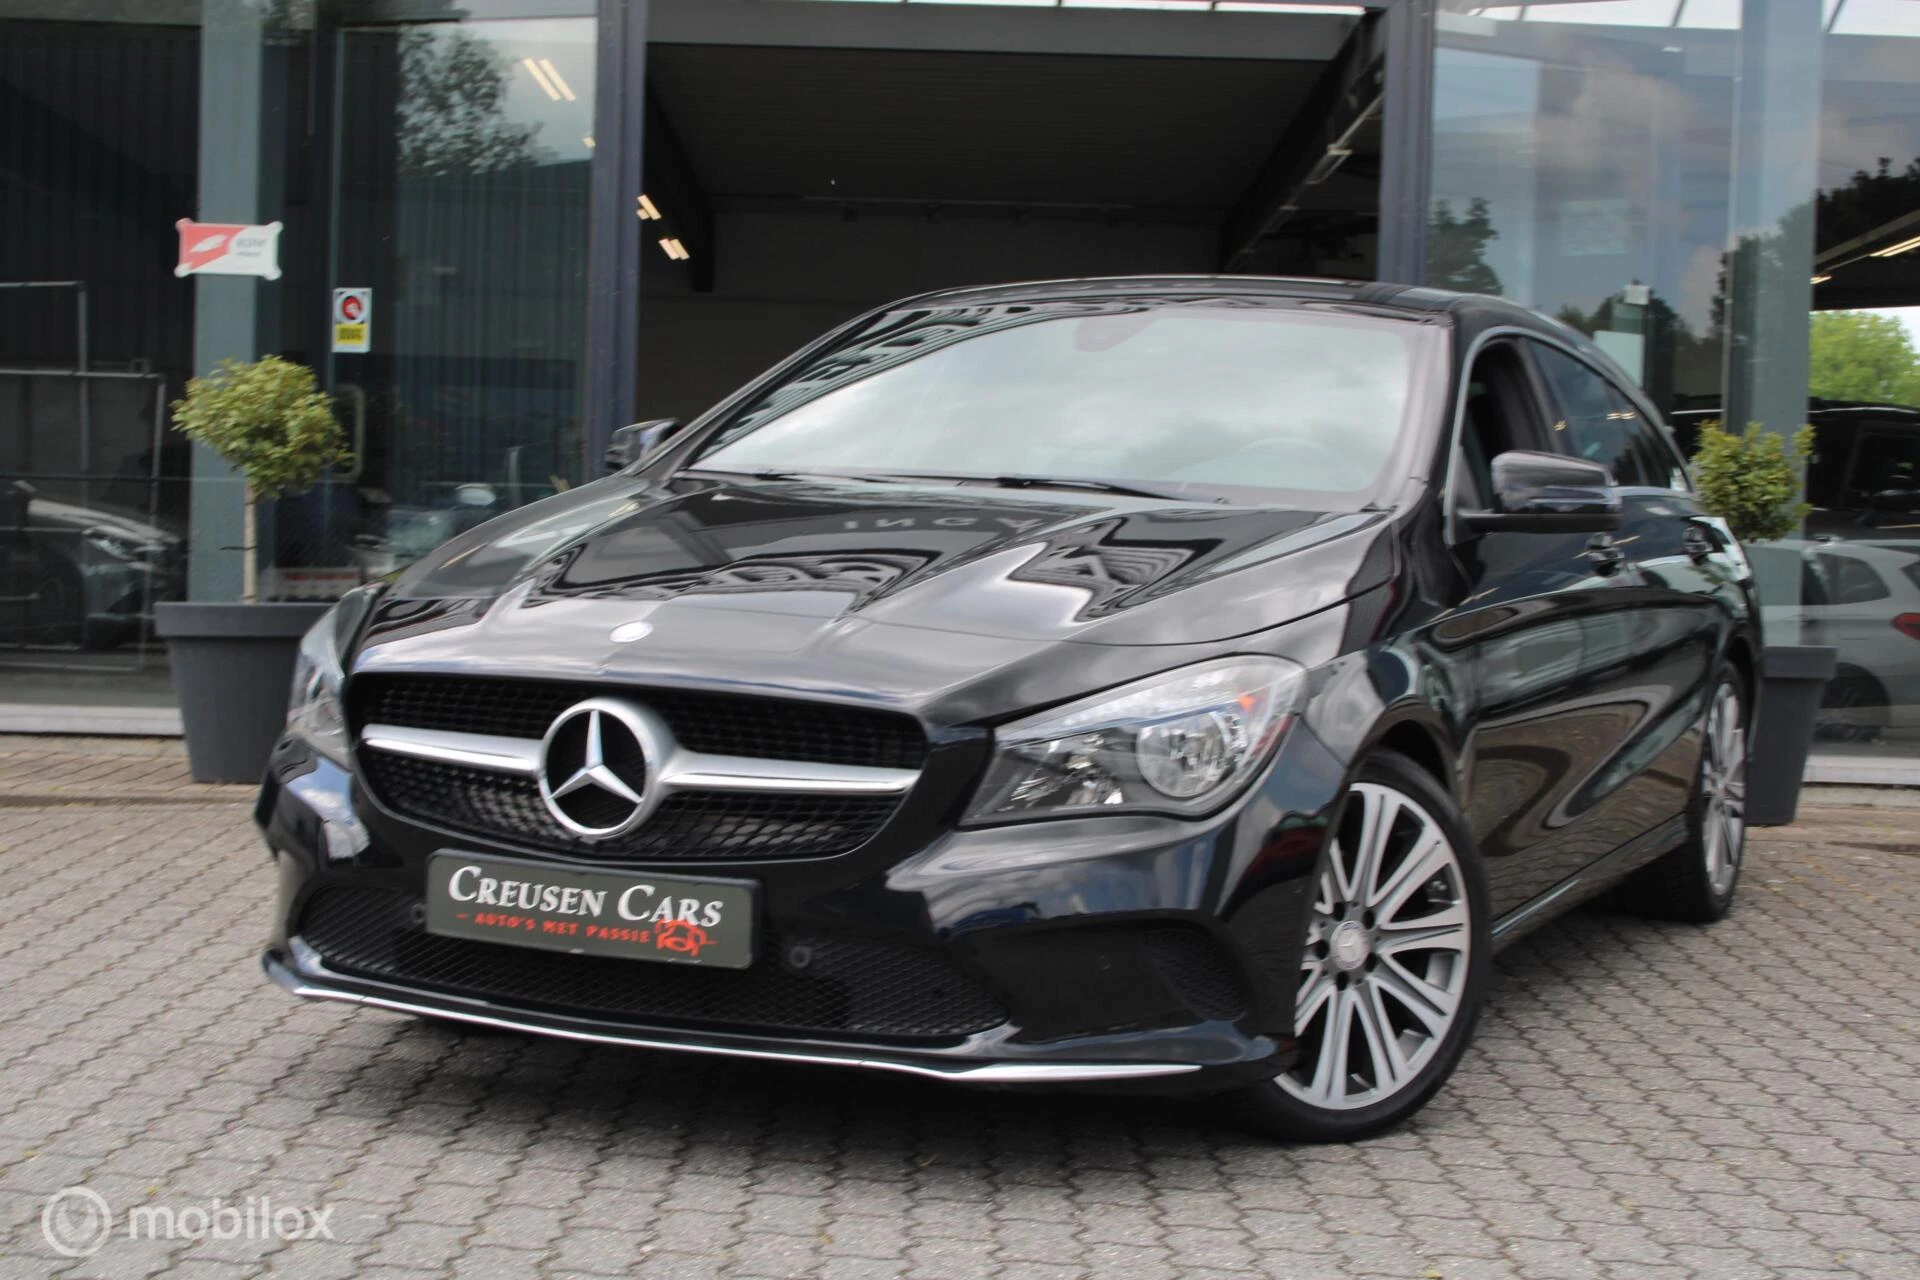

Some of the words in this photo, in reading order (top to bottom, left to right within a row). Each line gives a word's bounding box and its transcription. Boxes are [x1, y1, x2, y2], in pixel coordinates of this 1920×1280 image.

[448, 865, 608, 917] CREUSEN
[617, 884, 724, 927] CARS
[474, 911, 537, 931] AUTO'S
[585, 923, 650, 943] PASSIE
